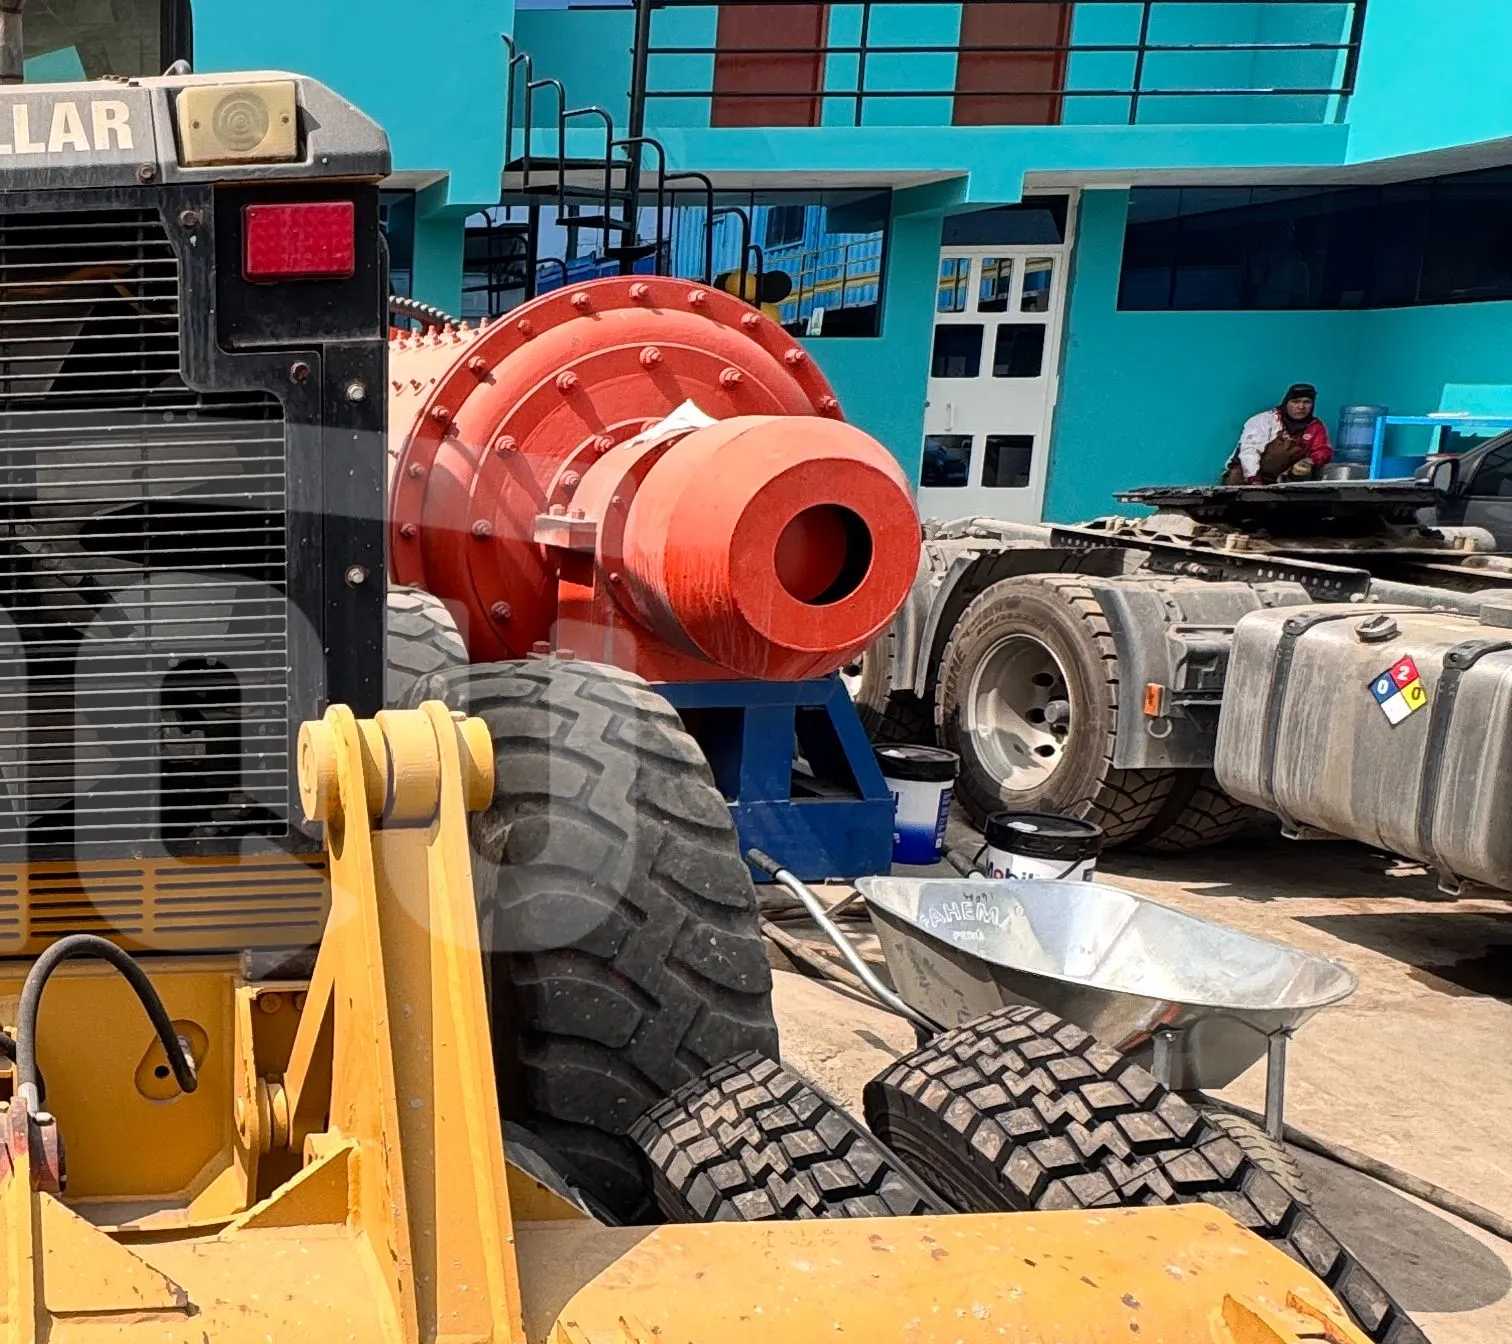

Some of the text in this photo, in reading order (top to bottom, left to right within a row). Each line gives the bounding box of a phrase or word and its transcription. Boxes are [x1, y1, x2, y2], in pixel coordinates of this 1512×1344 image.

[1397, 665, 1410, 681] 2
[1377, 679, 1388, 694] 0
[1412, 687, 1421, 700] 0
